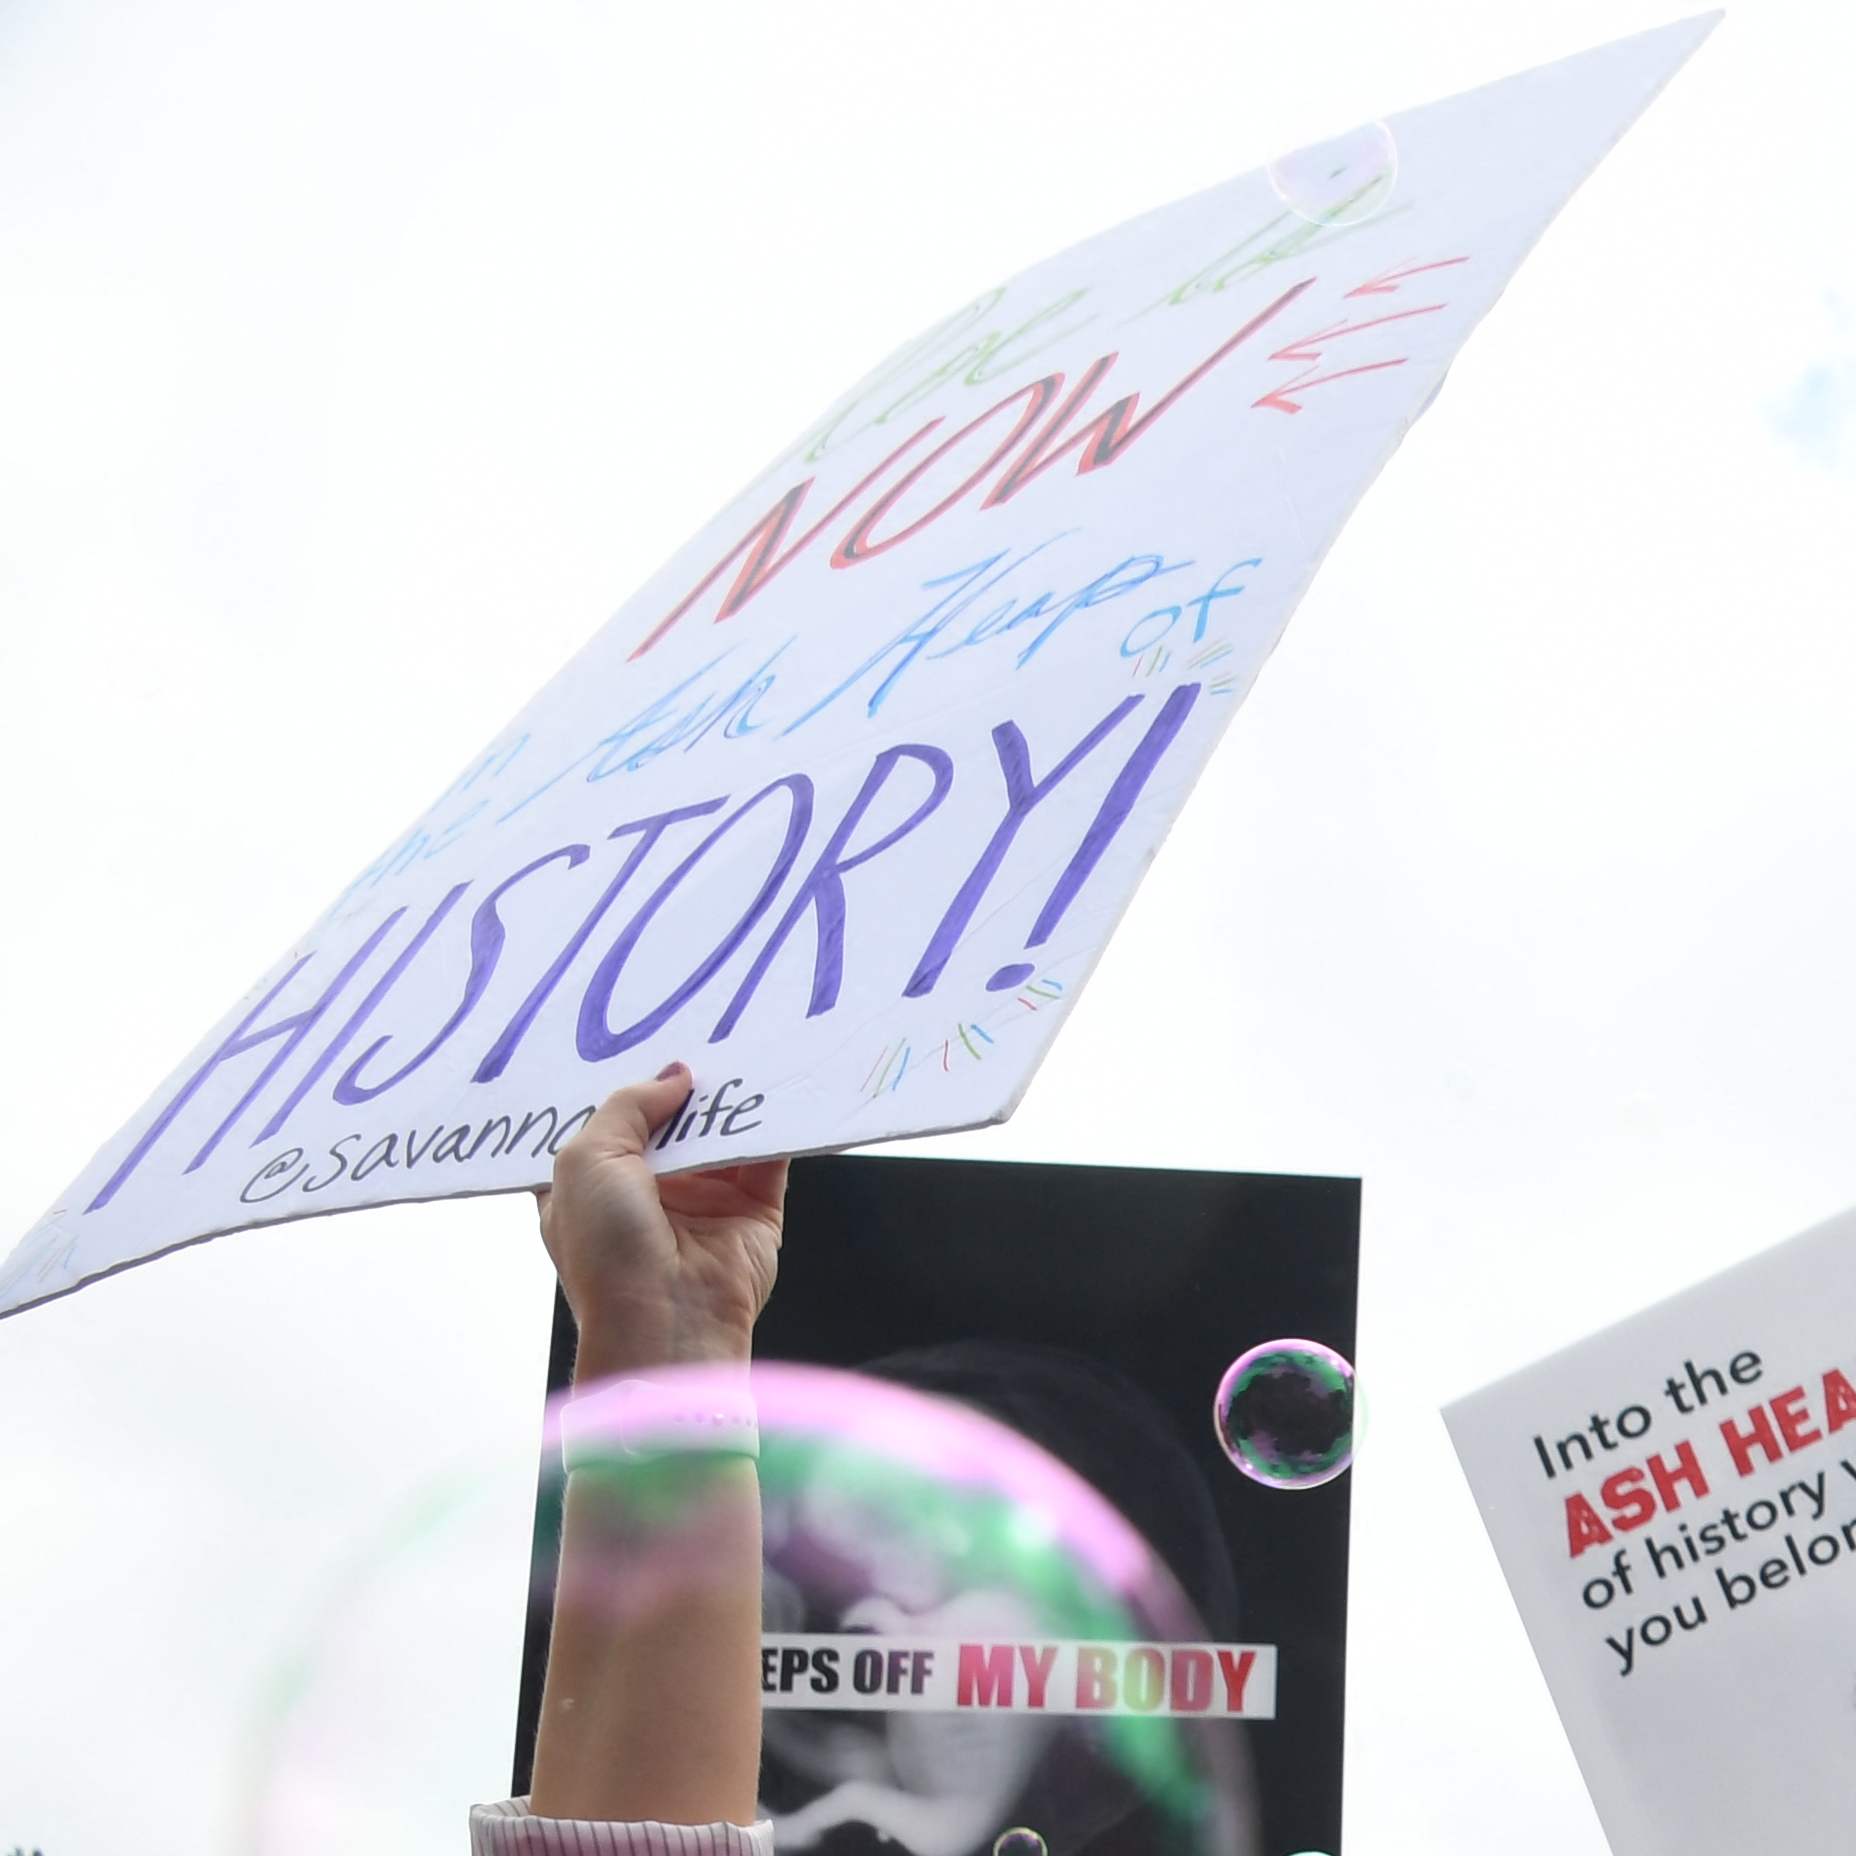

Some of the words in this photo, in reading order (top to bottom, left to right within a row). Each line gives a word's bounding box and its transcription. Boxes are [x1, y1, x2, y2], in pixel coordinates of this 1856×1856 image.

[634, 278, 1316, 660] NOW
[1118, 556, 1262, 657] of
[83, 682, 1202, 1215] HISTORY!
[1533, 1402, 1653, 1480] Into
[1664, 1347, 1765, 1425] the
[1562, 1442, 1708, 1558] ASH
[1579, 1548, 1635, 1613] of
[1644, 1468, 1828, 1578] history
[852, 1649, 934, 1694] OFF
[957, 1643, 1057, 1709] MY
[1075, 1645, 1257, 1713] BODY
[1604, 1600, 1708, 1676] you
